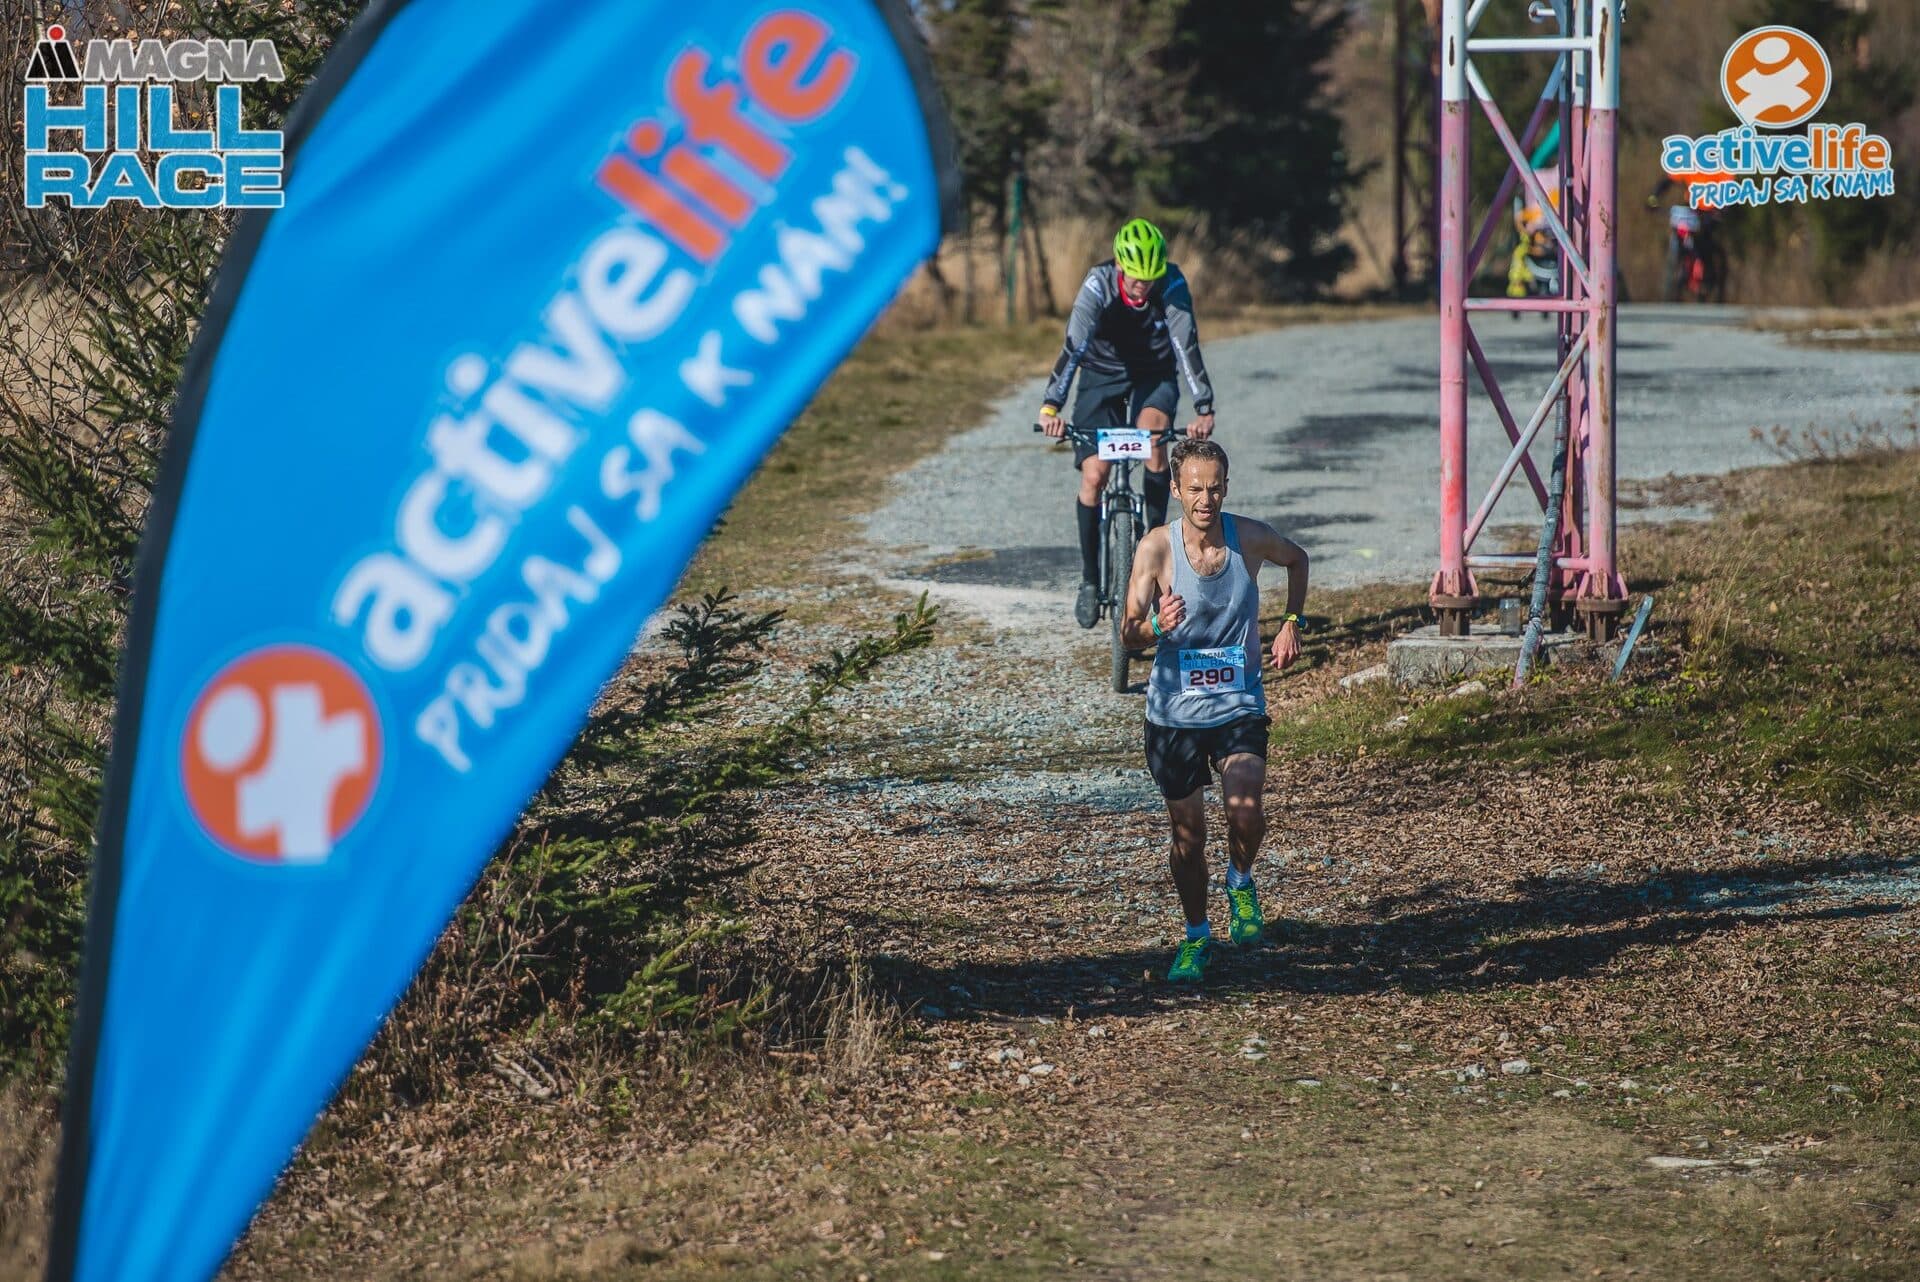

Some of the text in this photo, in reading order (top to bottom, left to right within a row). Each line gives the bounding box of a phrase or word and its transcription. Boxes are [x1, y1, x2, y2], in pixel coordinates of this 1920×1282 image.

[1107, 442, 1142, 452] 142
[416, 506, 621, 773] PRIDAJ
[601, 409, 706, 521] SA
[680, 331, 754, 405] K
[1190, 667, 1234, 685] 290
